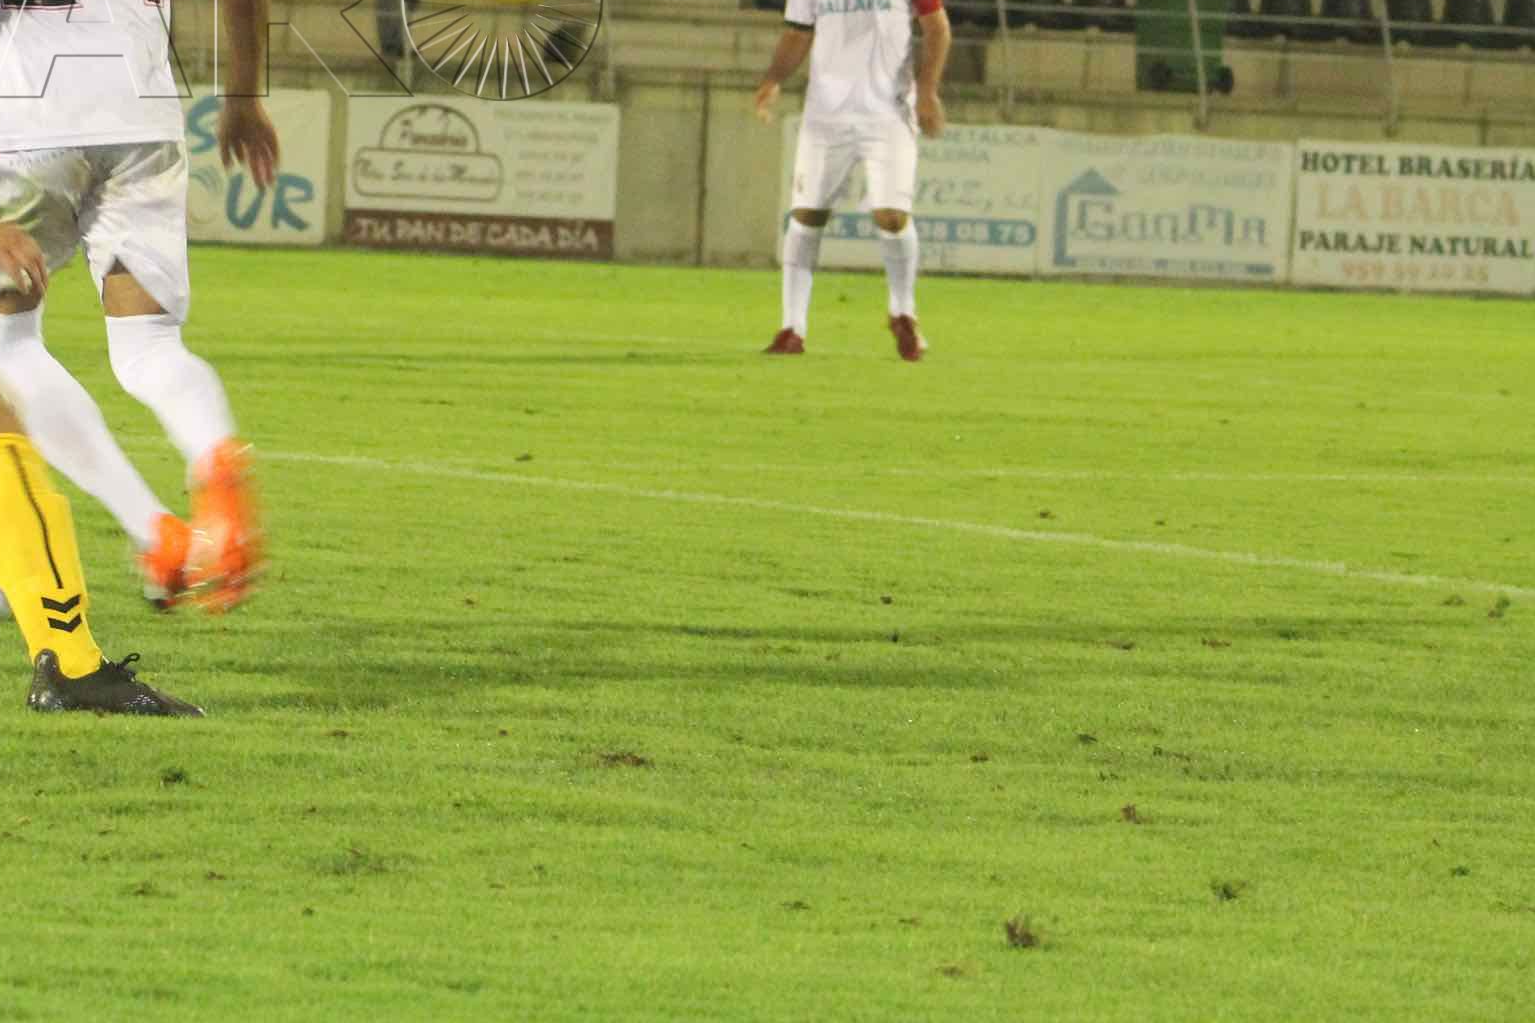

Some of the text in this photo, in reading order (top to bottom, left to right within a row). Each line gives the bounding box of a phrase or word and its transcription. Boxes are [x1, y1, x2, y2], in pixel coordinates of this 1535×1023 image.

[1301, 151, 1391, 176] HOTEL
[396, 218, 446, 244] PAN
[449, 221, 483, 245] DE
[486, 223, 555, 249] CADA
[1299, 230, 1534, 258] PARAJE NATURAL
